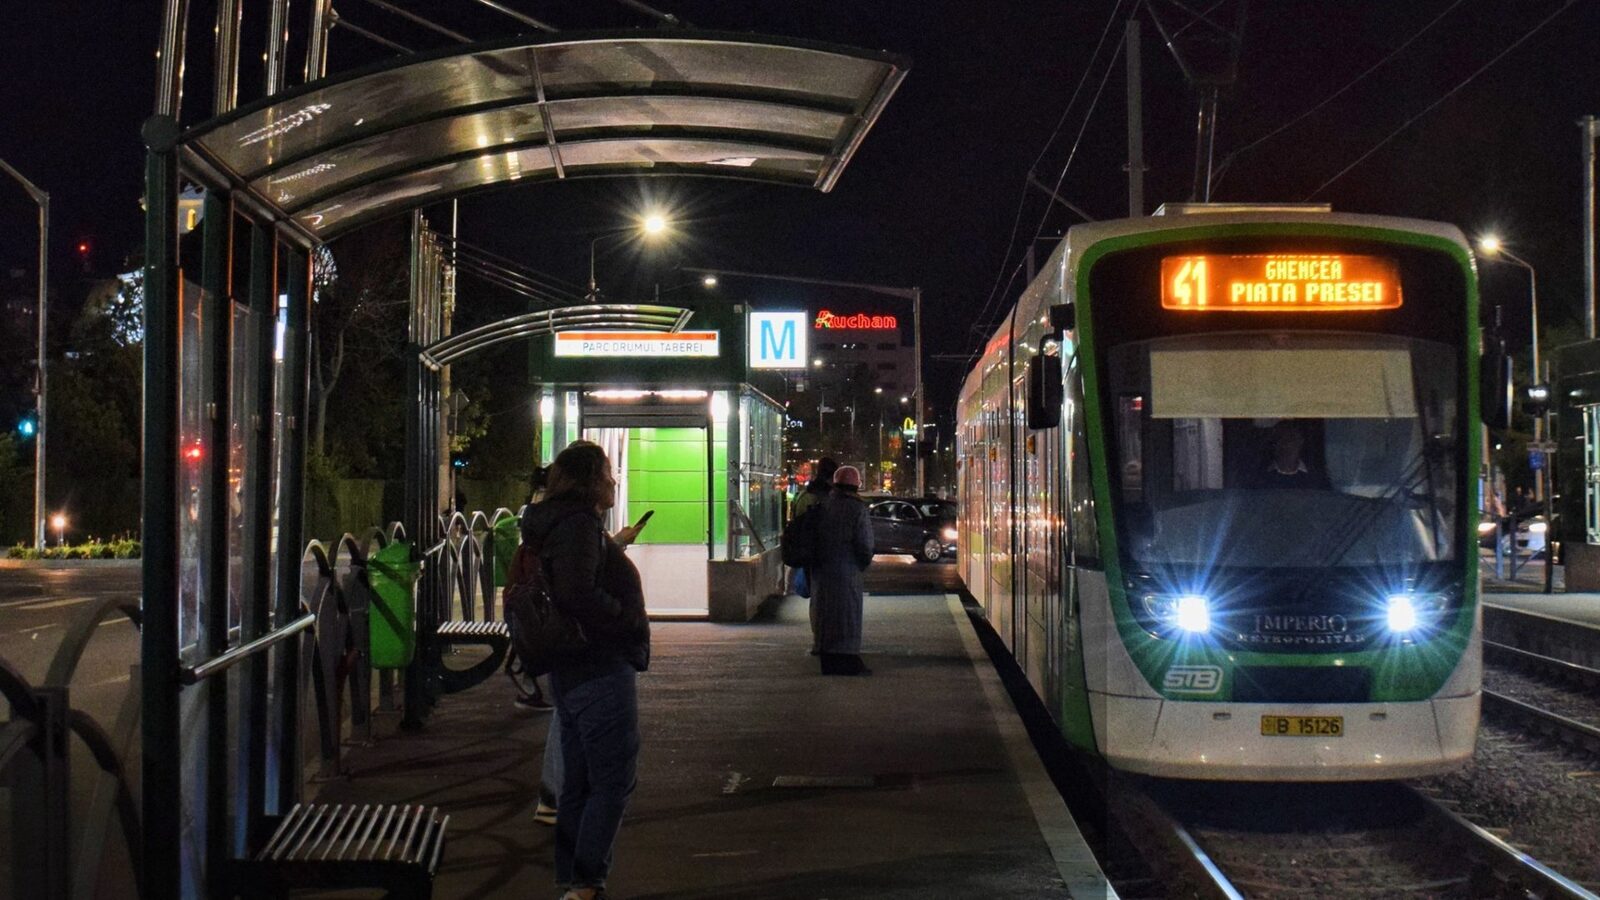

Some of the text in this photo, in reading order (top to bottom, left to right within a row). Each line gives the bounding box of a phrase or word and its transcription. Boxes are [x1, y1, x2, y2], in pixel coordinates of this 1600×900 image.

[1265, 260, 1342, 280] GHENCEA
[1173, 258, 1207, 305] 41
[1230, 282, 1383, 303] PIATA PRESEI
[814, 310, 897, 329] Auchan
[582, 342, 703, 352] PARC DRUMUL TABEREI
[760, 319, 796, 360] M
[1254, 614, 1348, 634] IMPERIO
[1162, 670, 1218, 688] STB
[1277, 718, 1340, 734] B 15126
